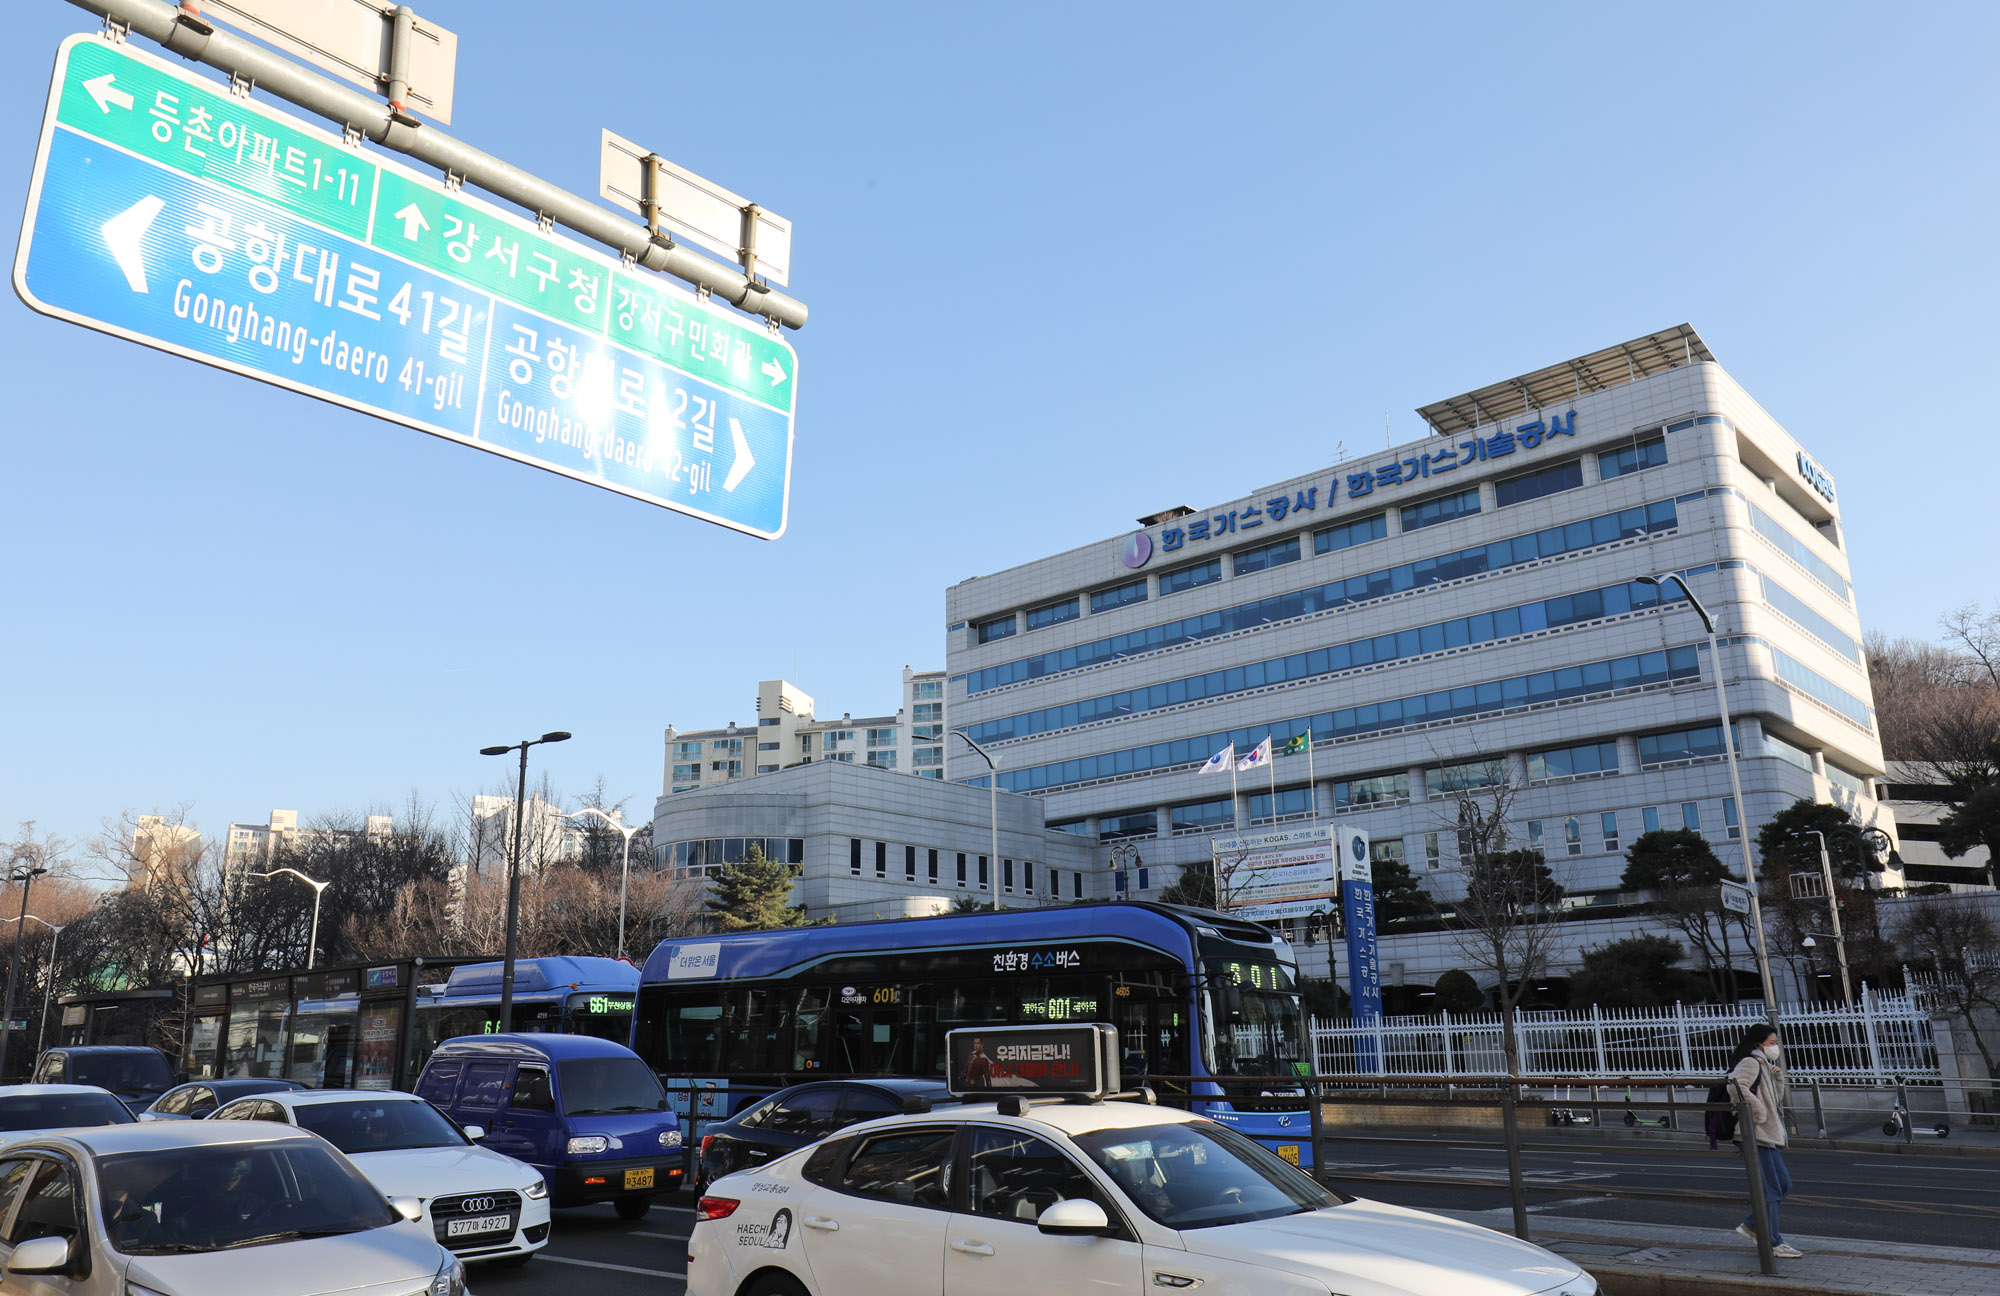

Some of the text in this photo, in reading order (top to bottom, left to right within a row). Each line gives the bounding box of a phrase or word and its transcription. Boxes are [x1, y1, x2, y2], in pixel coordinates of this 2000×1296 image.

[149, 90, 359, 206] 등촌아파트1-11
[442, 214, 599, 315] 강서구청
[184, 203, 472, 364] 공항대로41길
[173, 279, 463, 410] Gonghang-daero 41-gil
[1161, 487, 1318, 552] 한국가스공사
[1346, 409, 1577, 499] 한국가스기술공사
[1354, 887, 1370, 998] 한국가스공사
[1363, 888, 1379, 999] 한국가스기술공사
[680, 954, 717, 968] 더 맑은 서울
[993, 950, 1081, 972] 친환경 수소버스
[590, 997, 608, 1014] 661
[873, 988, 895, 1003] 601
[1048, 997, 1071, 1019] 601
[996, 1043, 1071, 1061] 우리지금만나!
[481, 1217, 507, 1231] 4927
[737, 1224, 769, 1234] HAECHI
[738, 1236, 764, 1247] SEOUL
